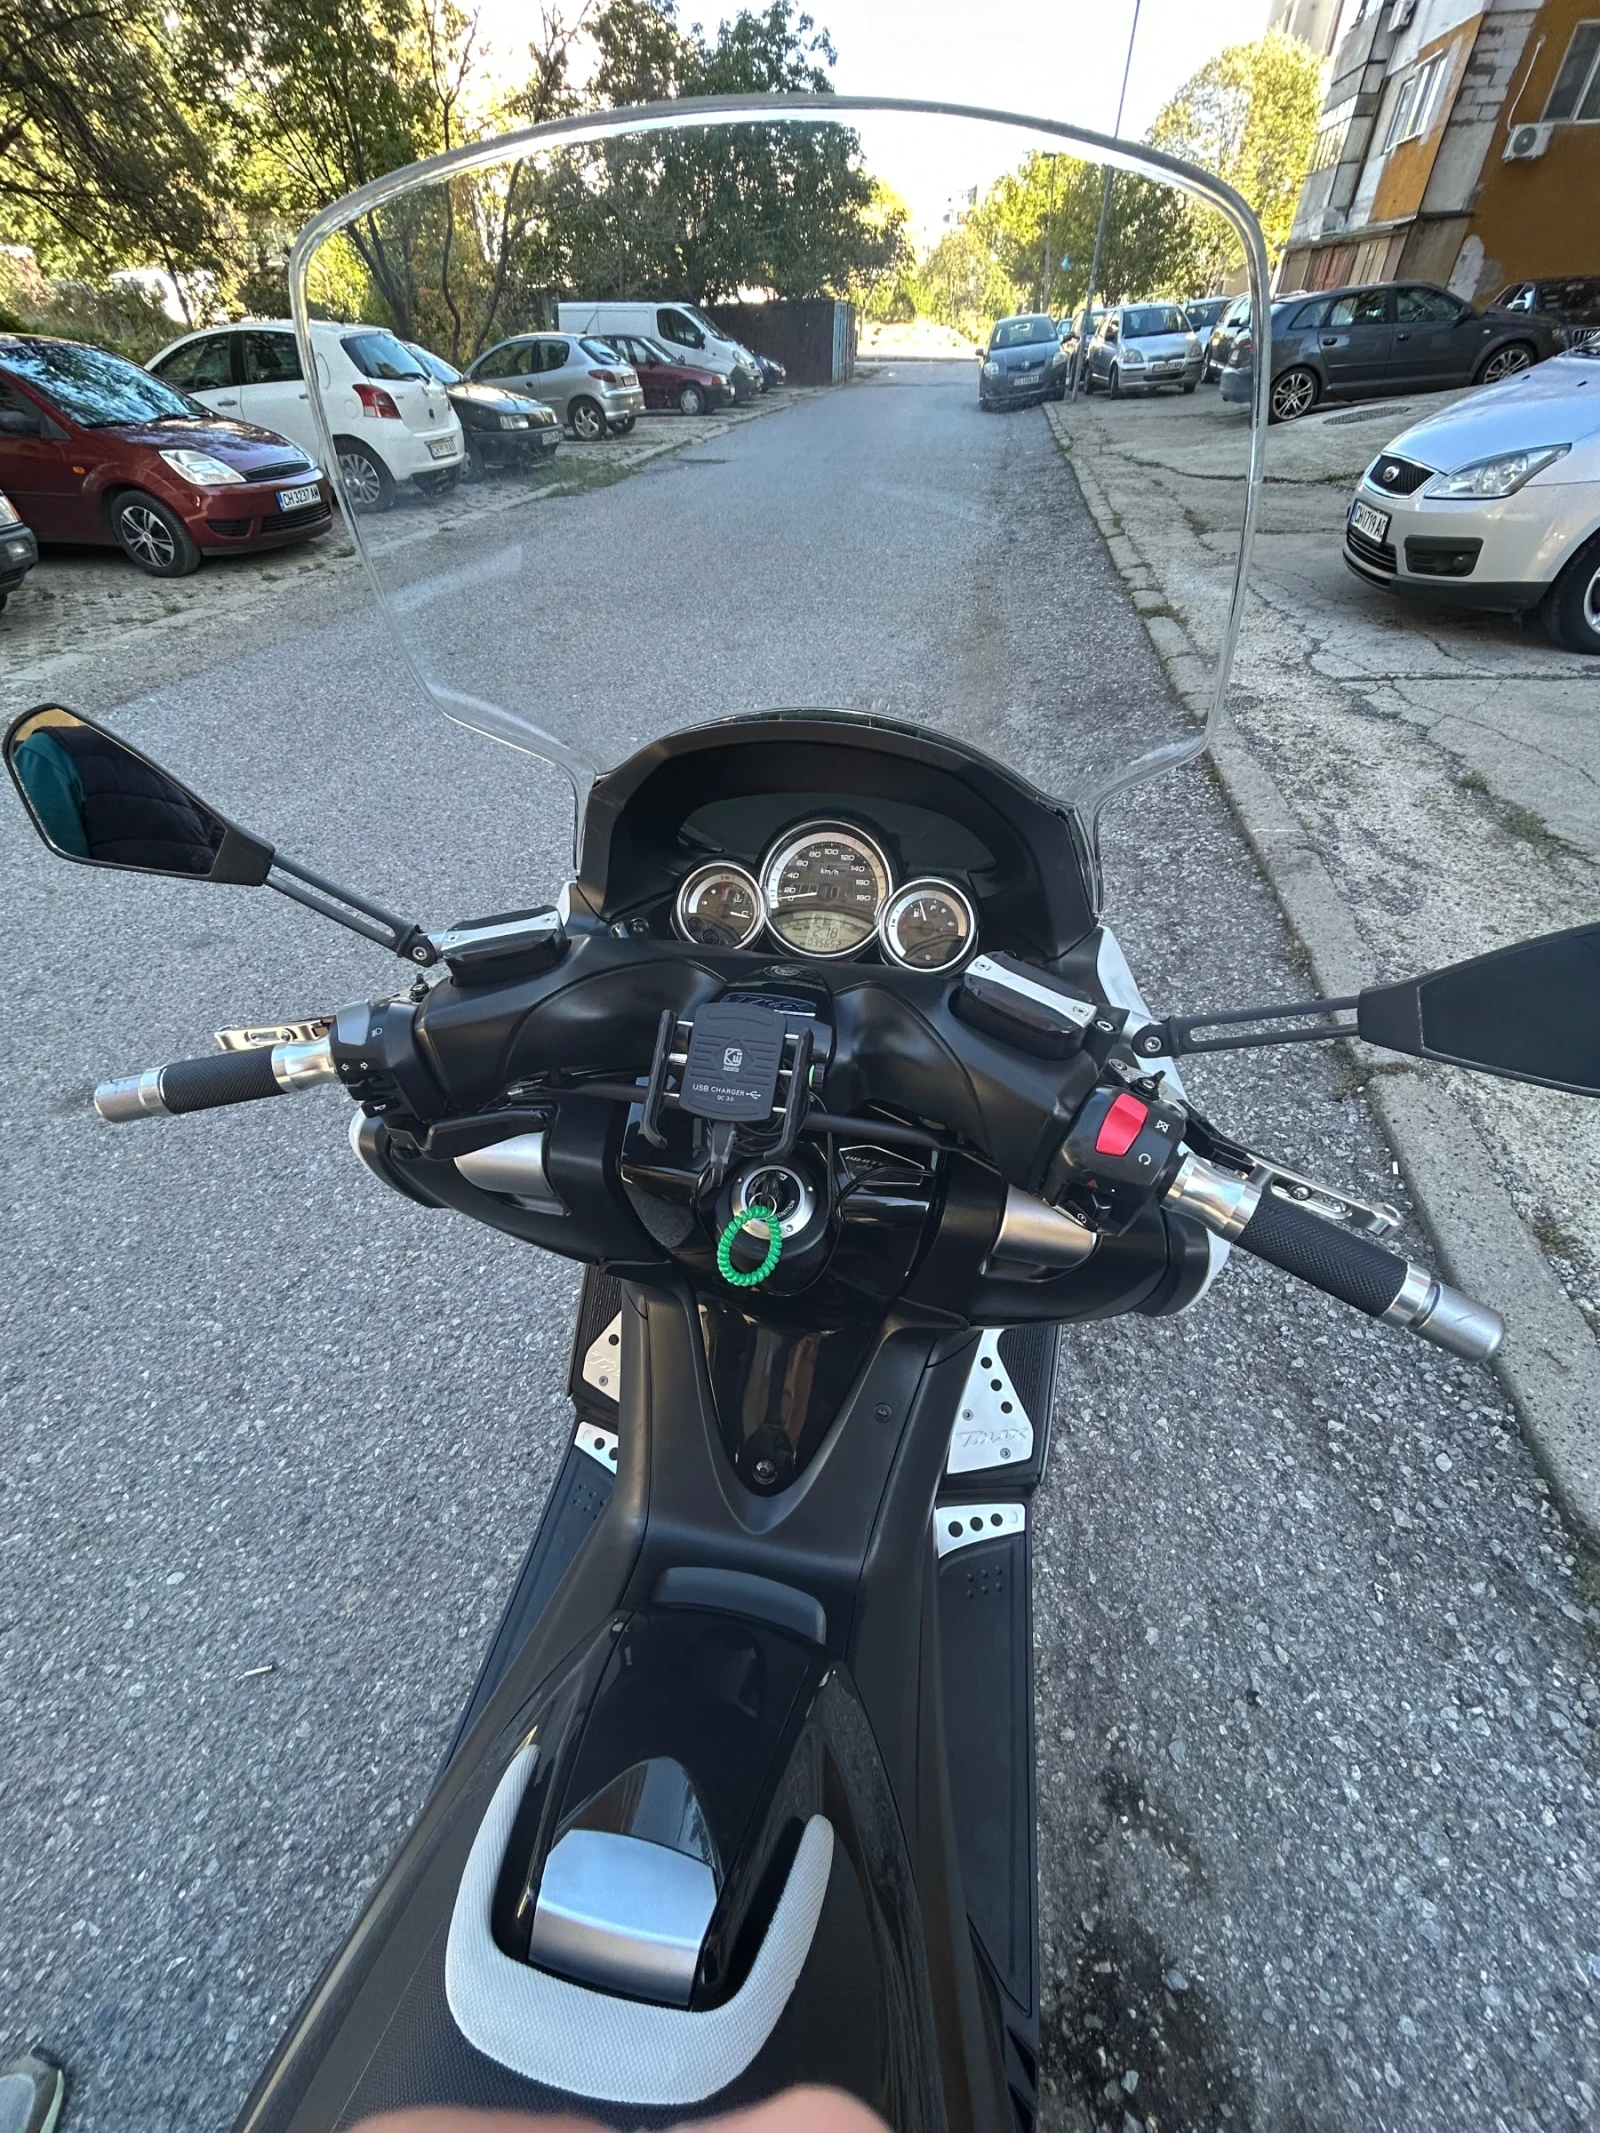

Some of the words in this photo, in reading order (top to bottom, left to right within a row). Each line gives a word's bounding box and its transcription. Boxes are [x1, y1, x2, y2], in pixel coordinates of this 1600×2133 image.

[808, 850, 821, 858] 80
[824, 848, 839, 856] 100
[820, 868, 839, 876] km/h
[812, 925, 839, 939] 2:18
[806, 938, 842, 949] 035652
[692, 1083, 709, 1092] USB
[710, 1086, 745, 1096] CHARGER
